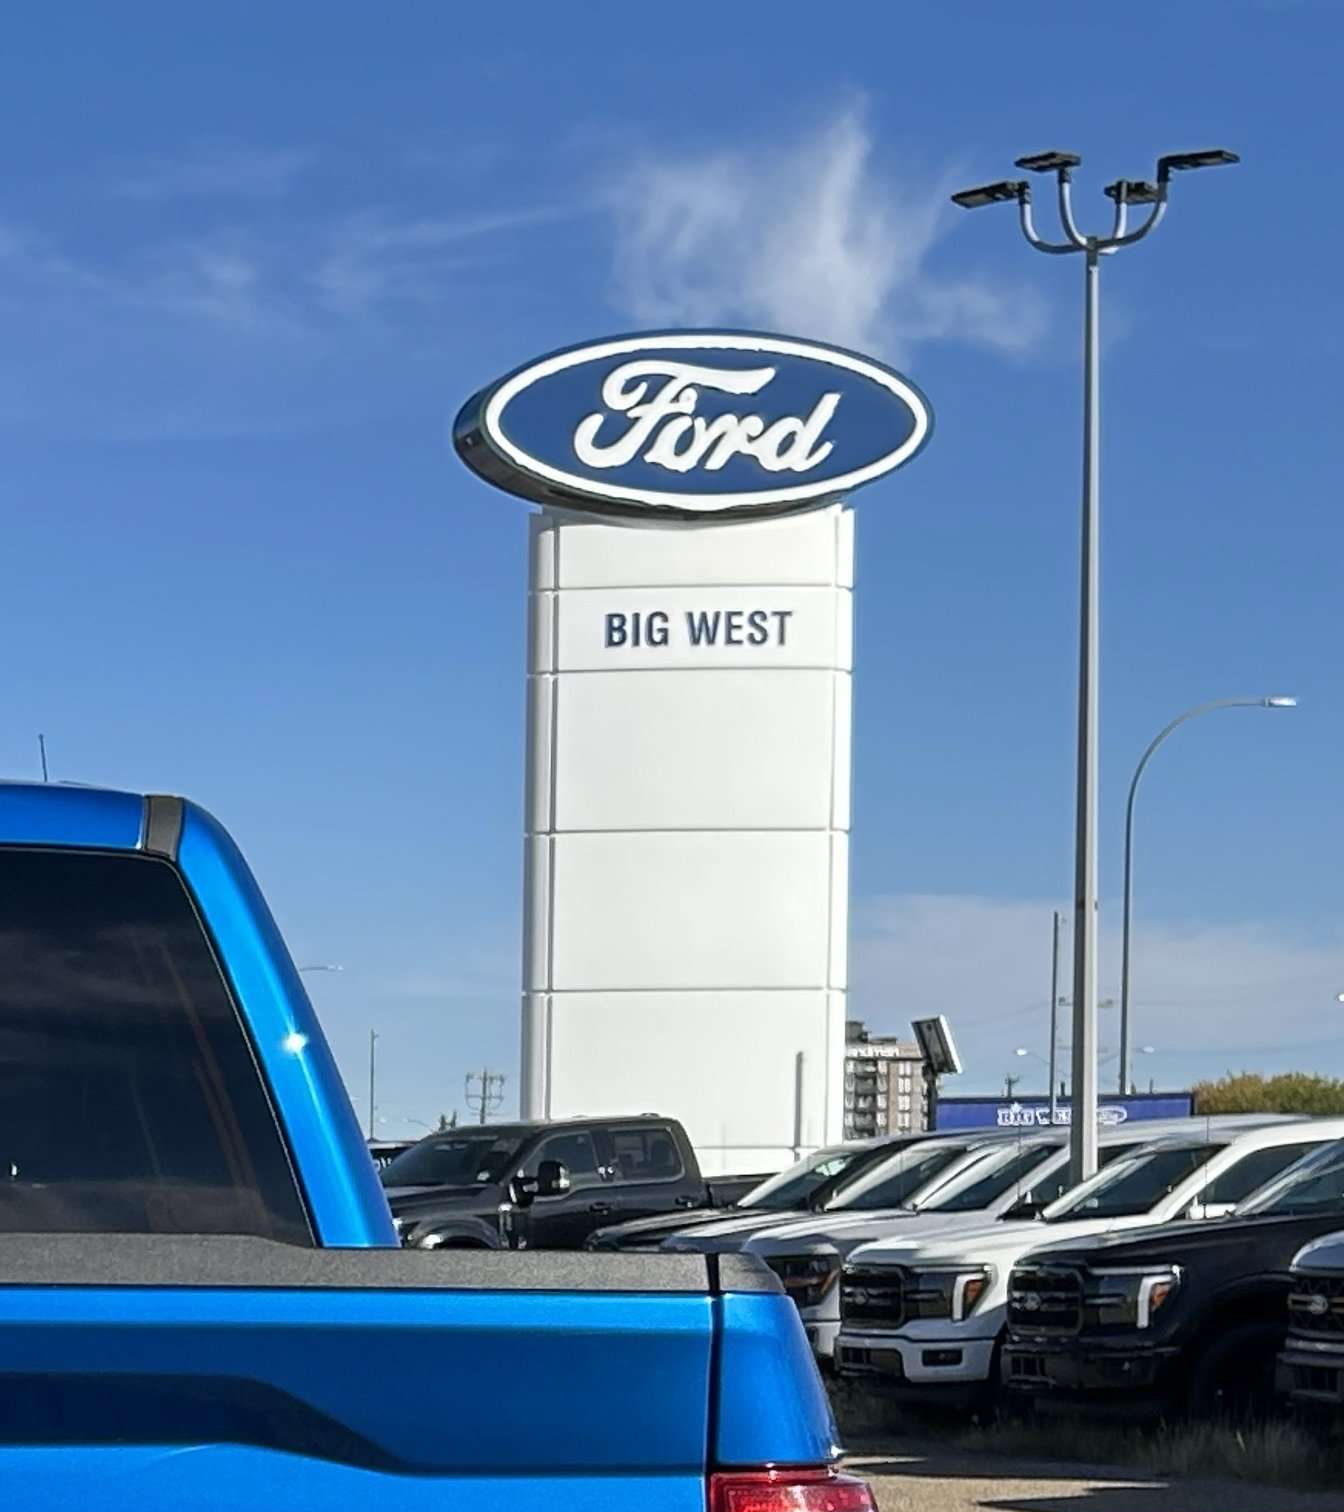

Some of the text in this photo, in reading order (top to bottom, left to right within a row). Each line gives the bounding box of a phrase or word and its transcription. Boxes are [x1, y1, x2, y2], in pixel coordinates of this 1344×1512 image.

[574, 360, 841, 472] Ford
[604, 610, 793, 648] BIG WEST
